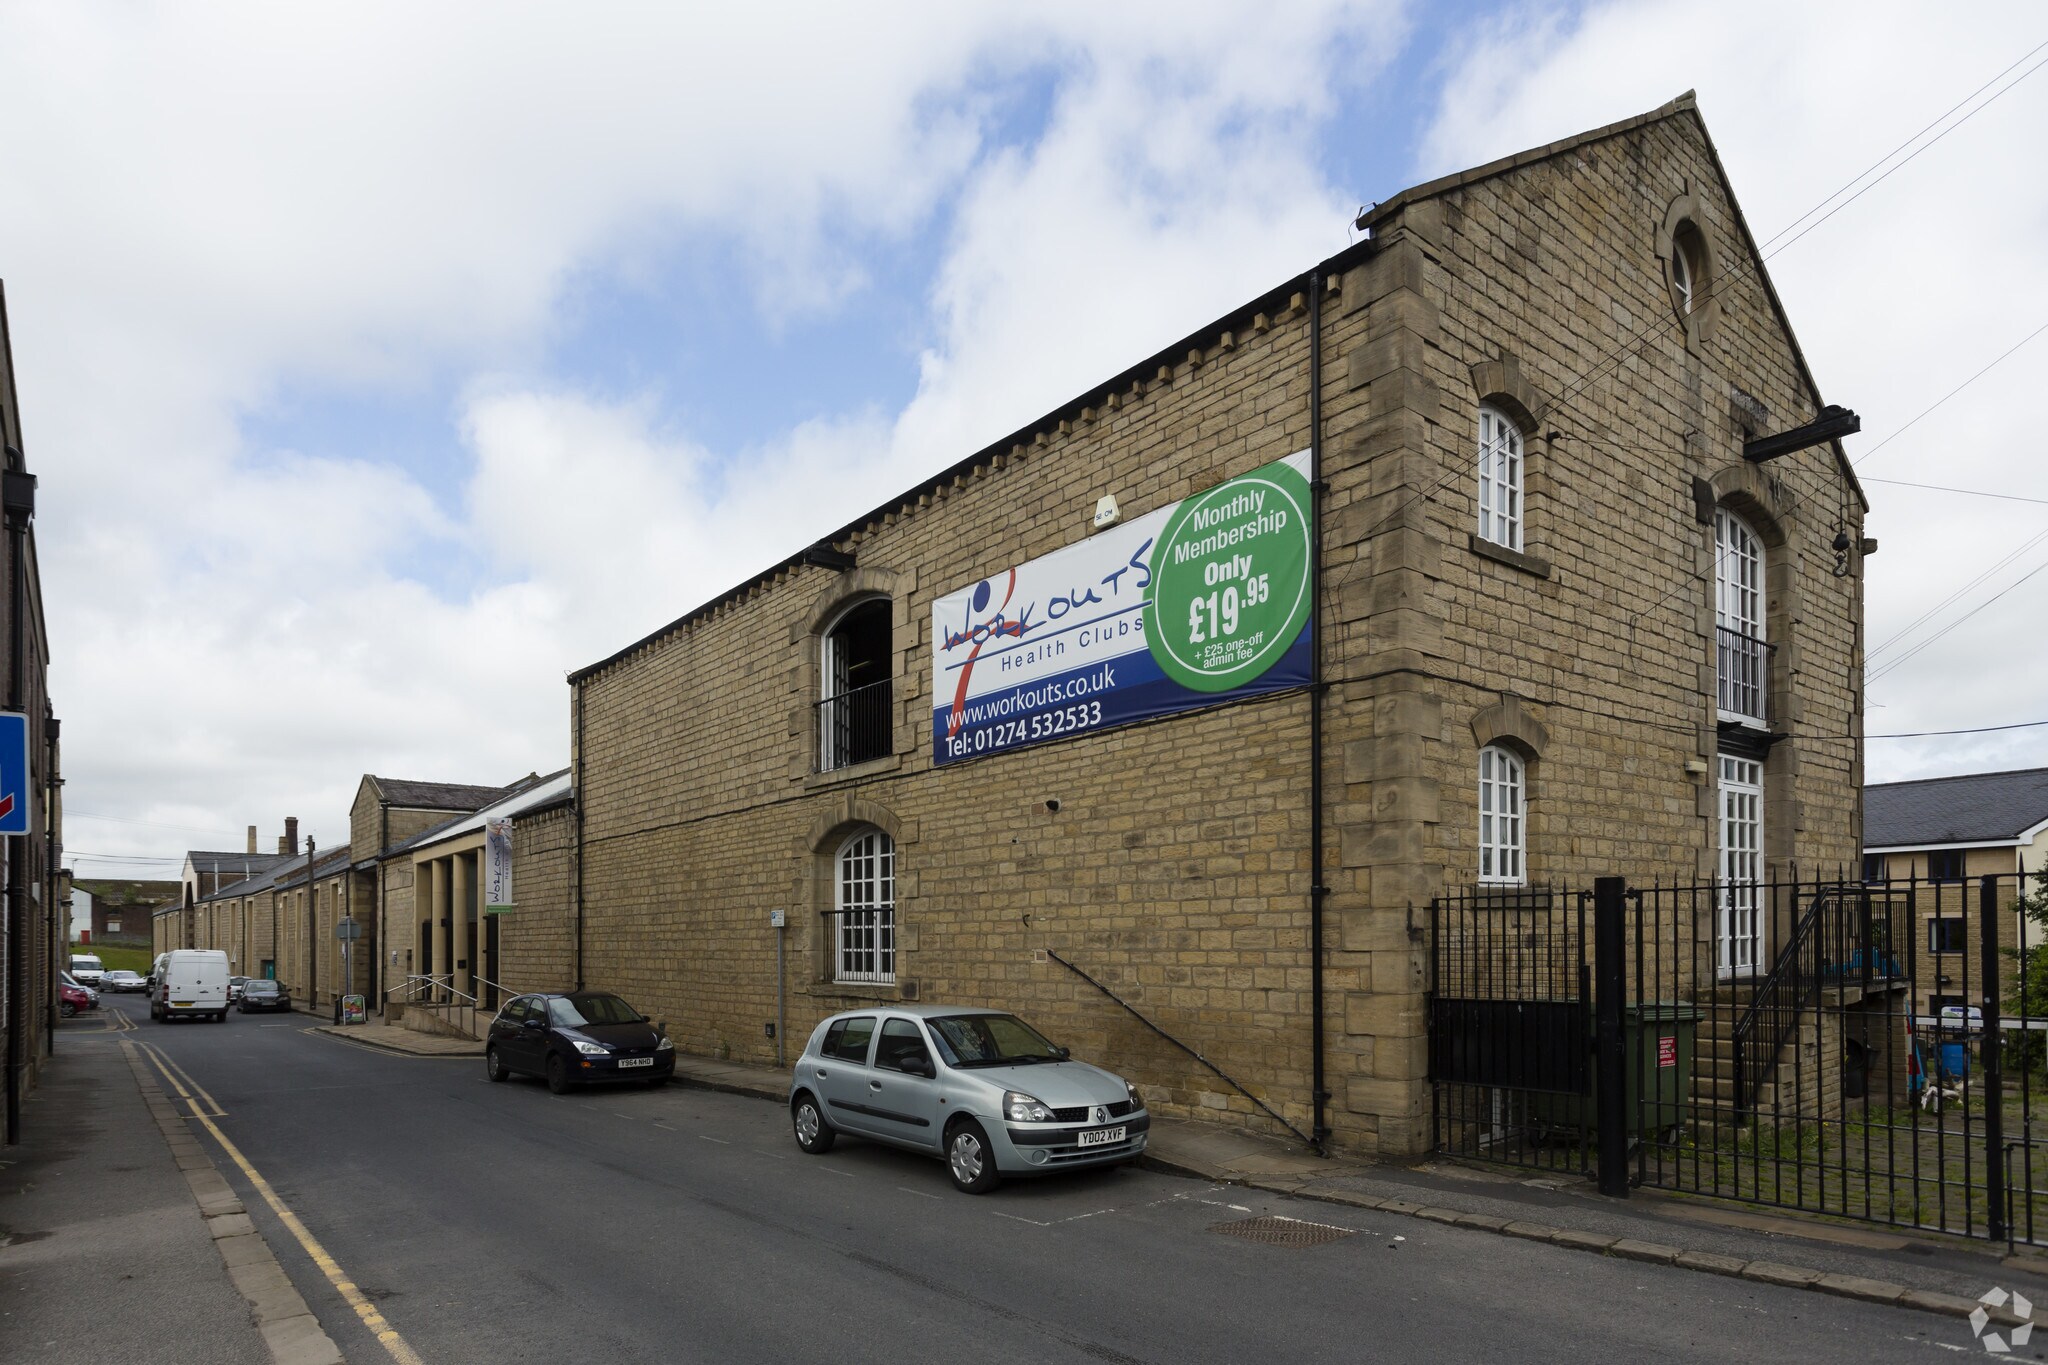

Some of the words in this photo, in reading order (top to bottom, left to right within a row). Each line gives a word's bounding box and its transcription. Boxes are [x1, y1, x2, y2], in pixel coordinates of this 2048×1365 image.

[1194, 490, 1265, 532] Monthly
[1175, 509, 1287, 565] Membership
[1204, 554, 1253, 586] Only
[1001, 640, 1065, 672] Health
[1079, 617, 1143, 648] Clubs
[1203, 652, 1234, 669] admin
[1237, 647, 1253, 660] fee
[1204, 642, 1223, 658] £25
[1226, 631, 1263, 651] one-off
[945, 663, 1116, 729] www.workouts.co.uk
[945, 732, 972, 757] Tel:
[975, 719, 1027, 751] 01274
[1031, 701, 1102, 739] 532533
[1083, 1131, 1106, 1144] YD02
[1107, 1128, 1123, 1141] XVF
